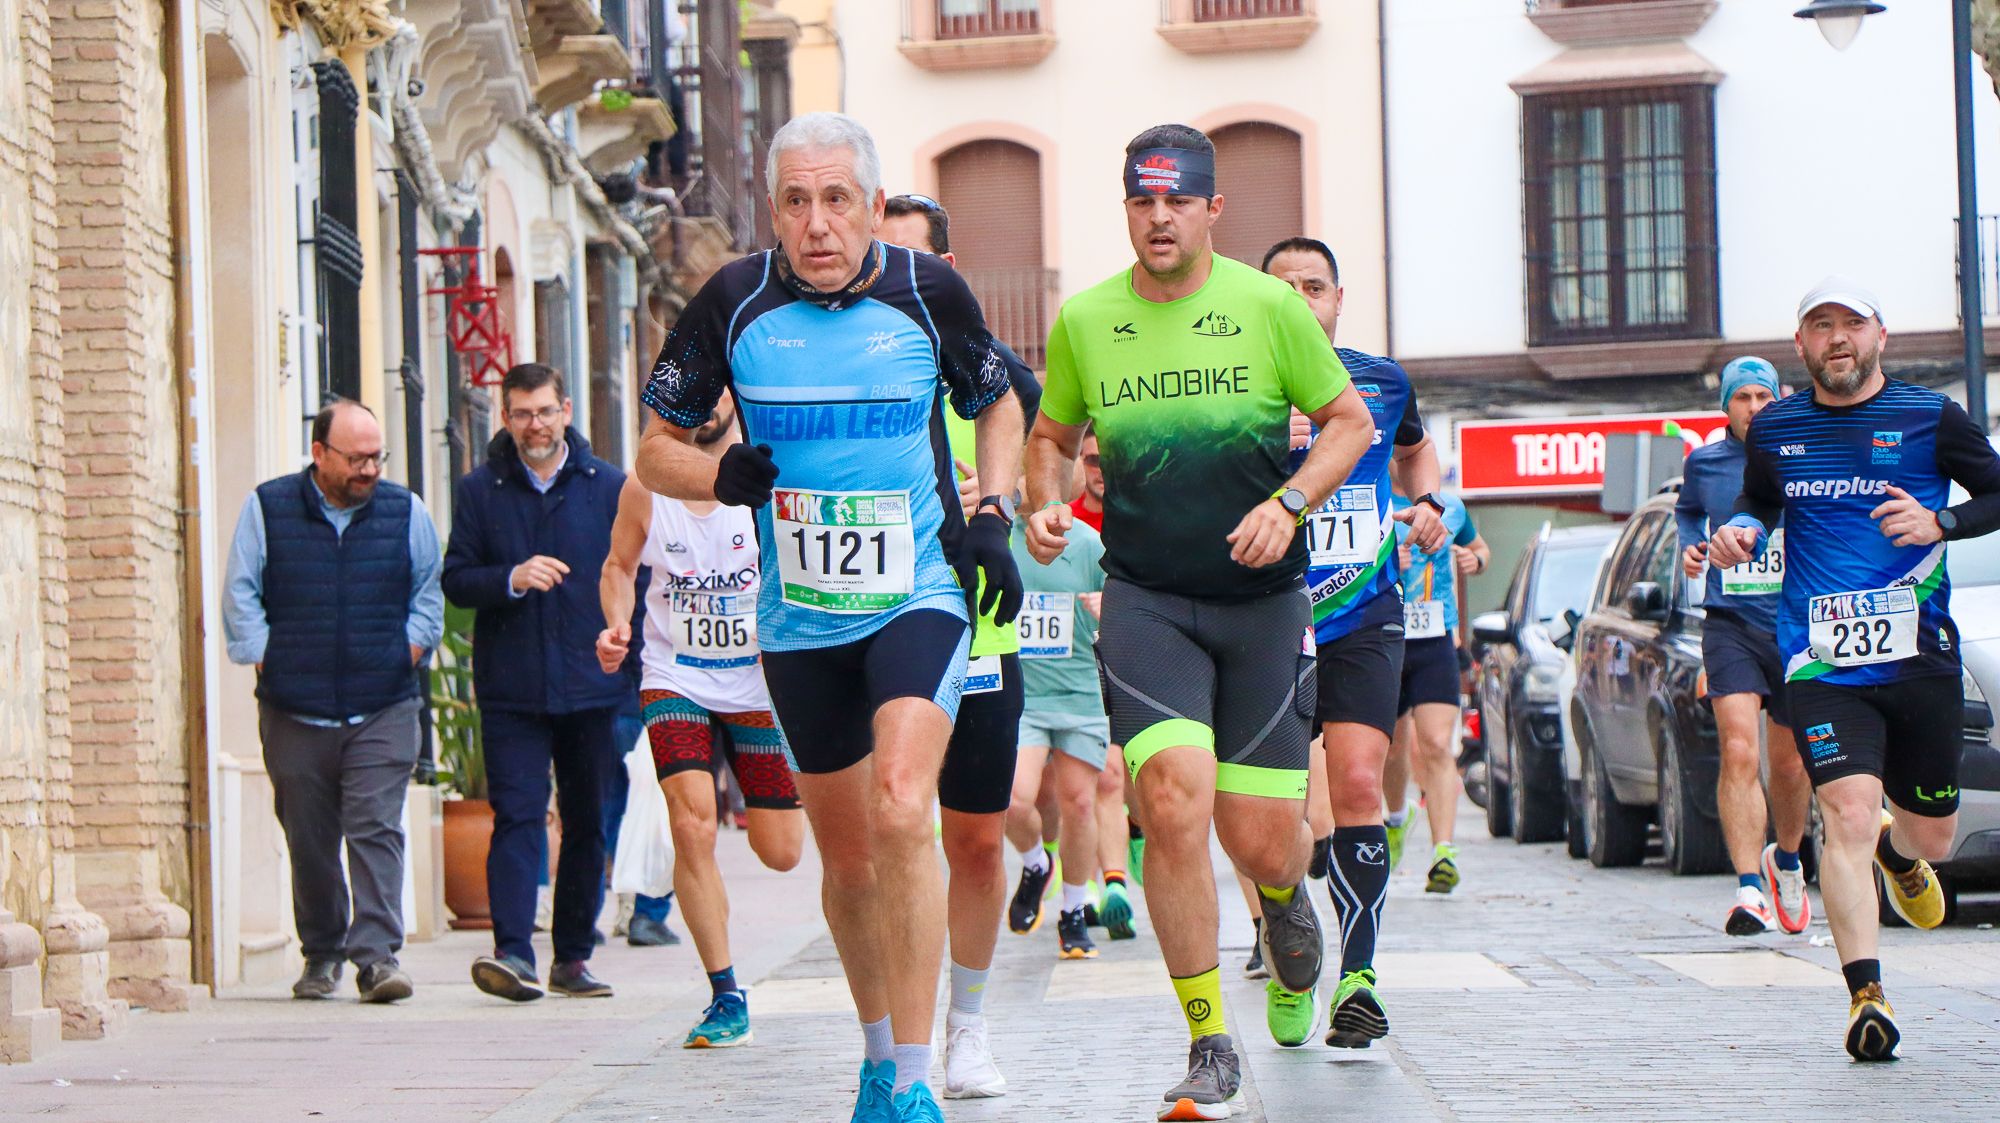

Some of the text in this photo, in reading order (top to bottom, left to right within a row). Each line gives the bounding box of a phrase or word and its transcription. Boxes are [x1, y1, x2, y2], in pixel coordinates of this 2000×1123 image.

[776, 339, 807, 348] TACTIC
[1211, 322, 1228, 335] LB
[870, 384, 912, 399] BAENA
[1100, 365, 1249, 407] LANDBIKE
[749, 404, 837, 441] MEDIA
[1511, 431, 1606, 477] TIENDA
[1784, 476, 1889, 500] enerplus
[784, 494, 824, 525] 10K
[791, 527, 886, 575] 1121
[1311, 569, 1355, 605] aratón
[1823, 595, 1856, 621] 21K
[683, 616, 748, 648] 1305
[1020, 615, 1061, 639] 516
[1832, 618, 1893, 659] 232
